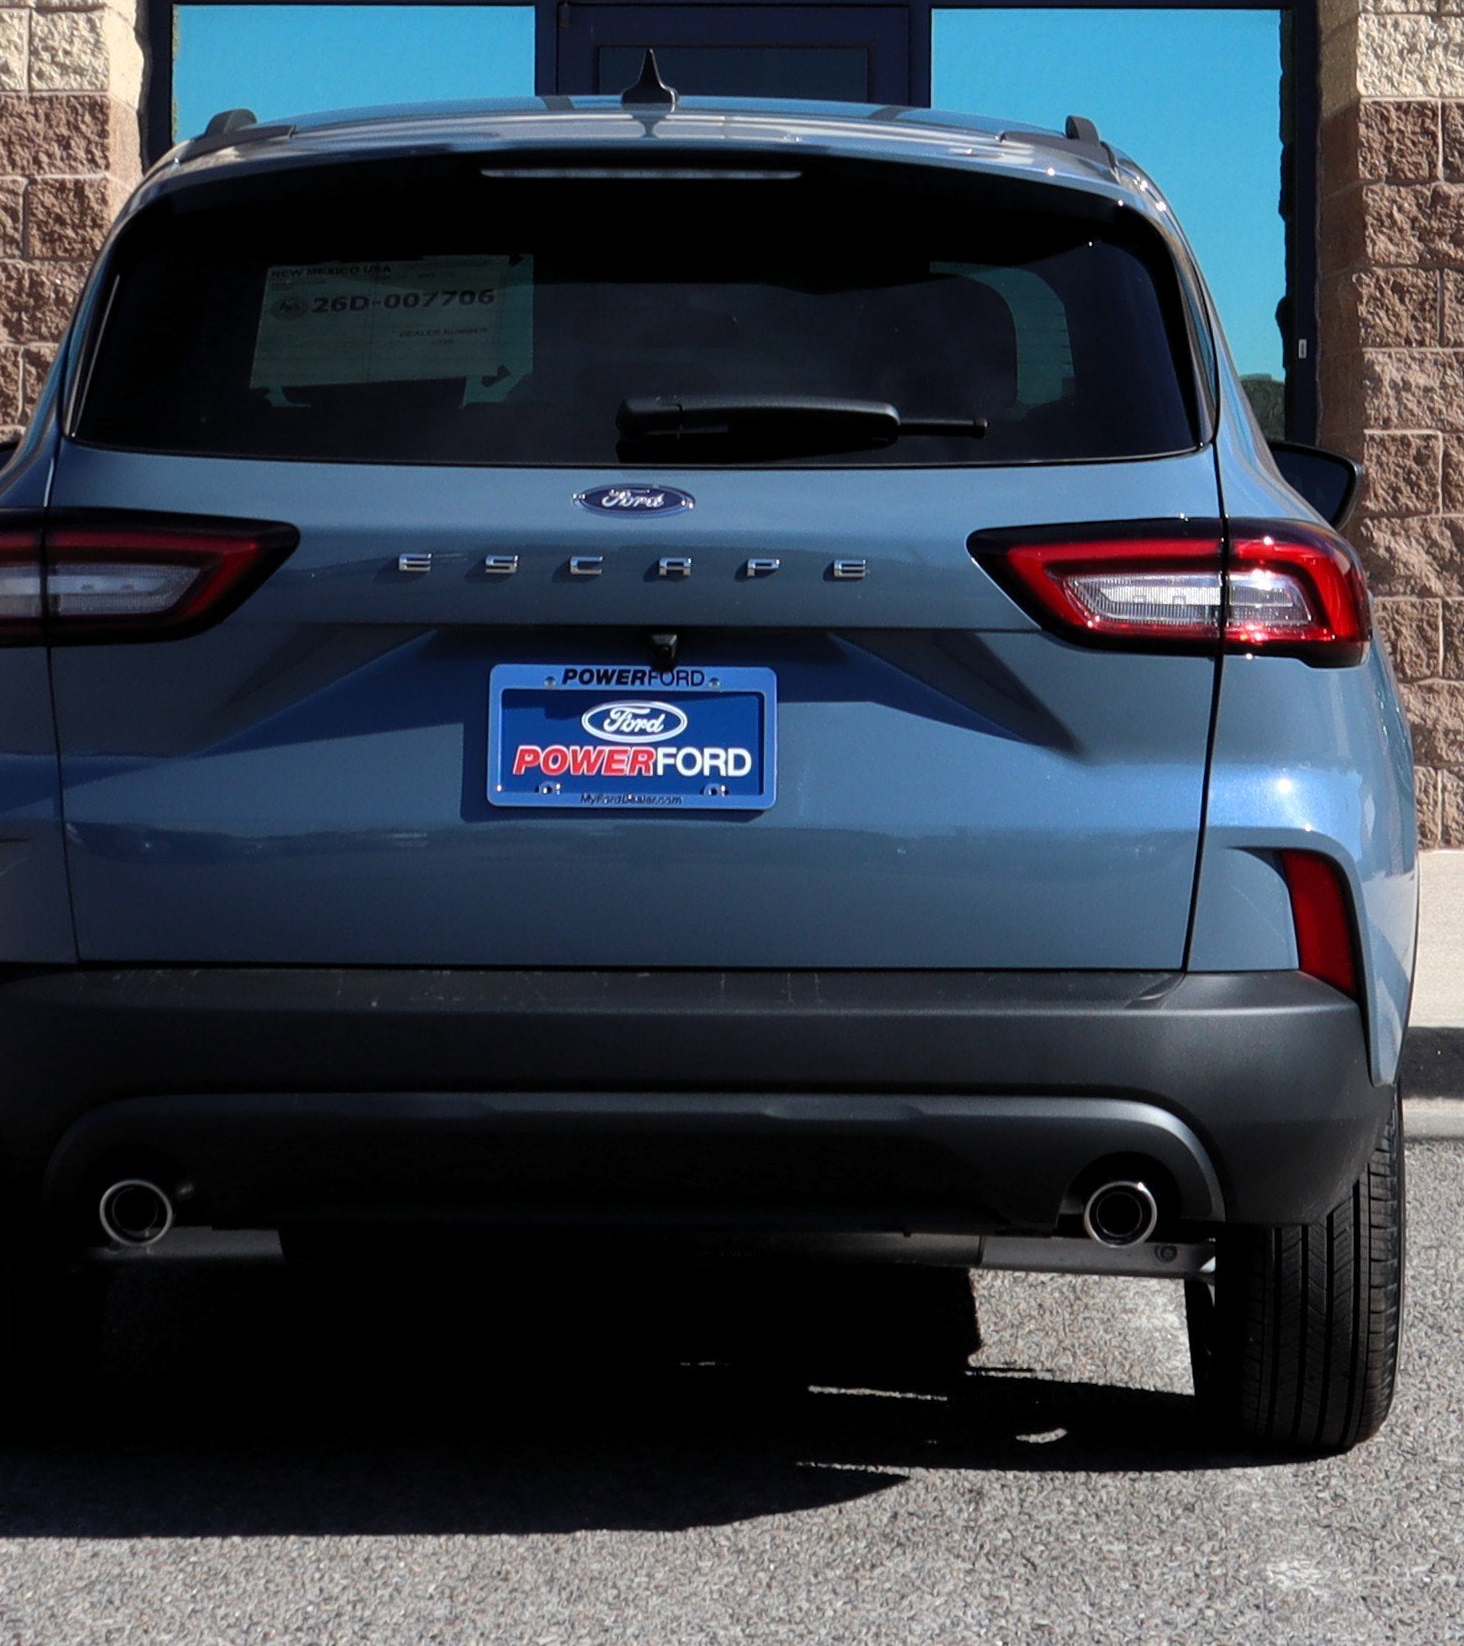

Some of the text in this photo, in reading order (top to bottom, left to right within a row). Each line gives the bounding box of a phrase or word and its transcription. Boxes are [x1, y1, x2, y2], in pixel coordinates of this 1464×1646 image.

[306, 266, 360, 276] MEXICO
[312, 288, 496, 314] 26D-007706
[601, 488, 665, 509] Ford
[398, 552, 868, 578] ESCAPE
[561, 667, 706, 687] POWERFORD
[603, 706, 665, 734] Ford
[512, 744, 753, 778] POWERFORD
